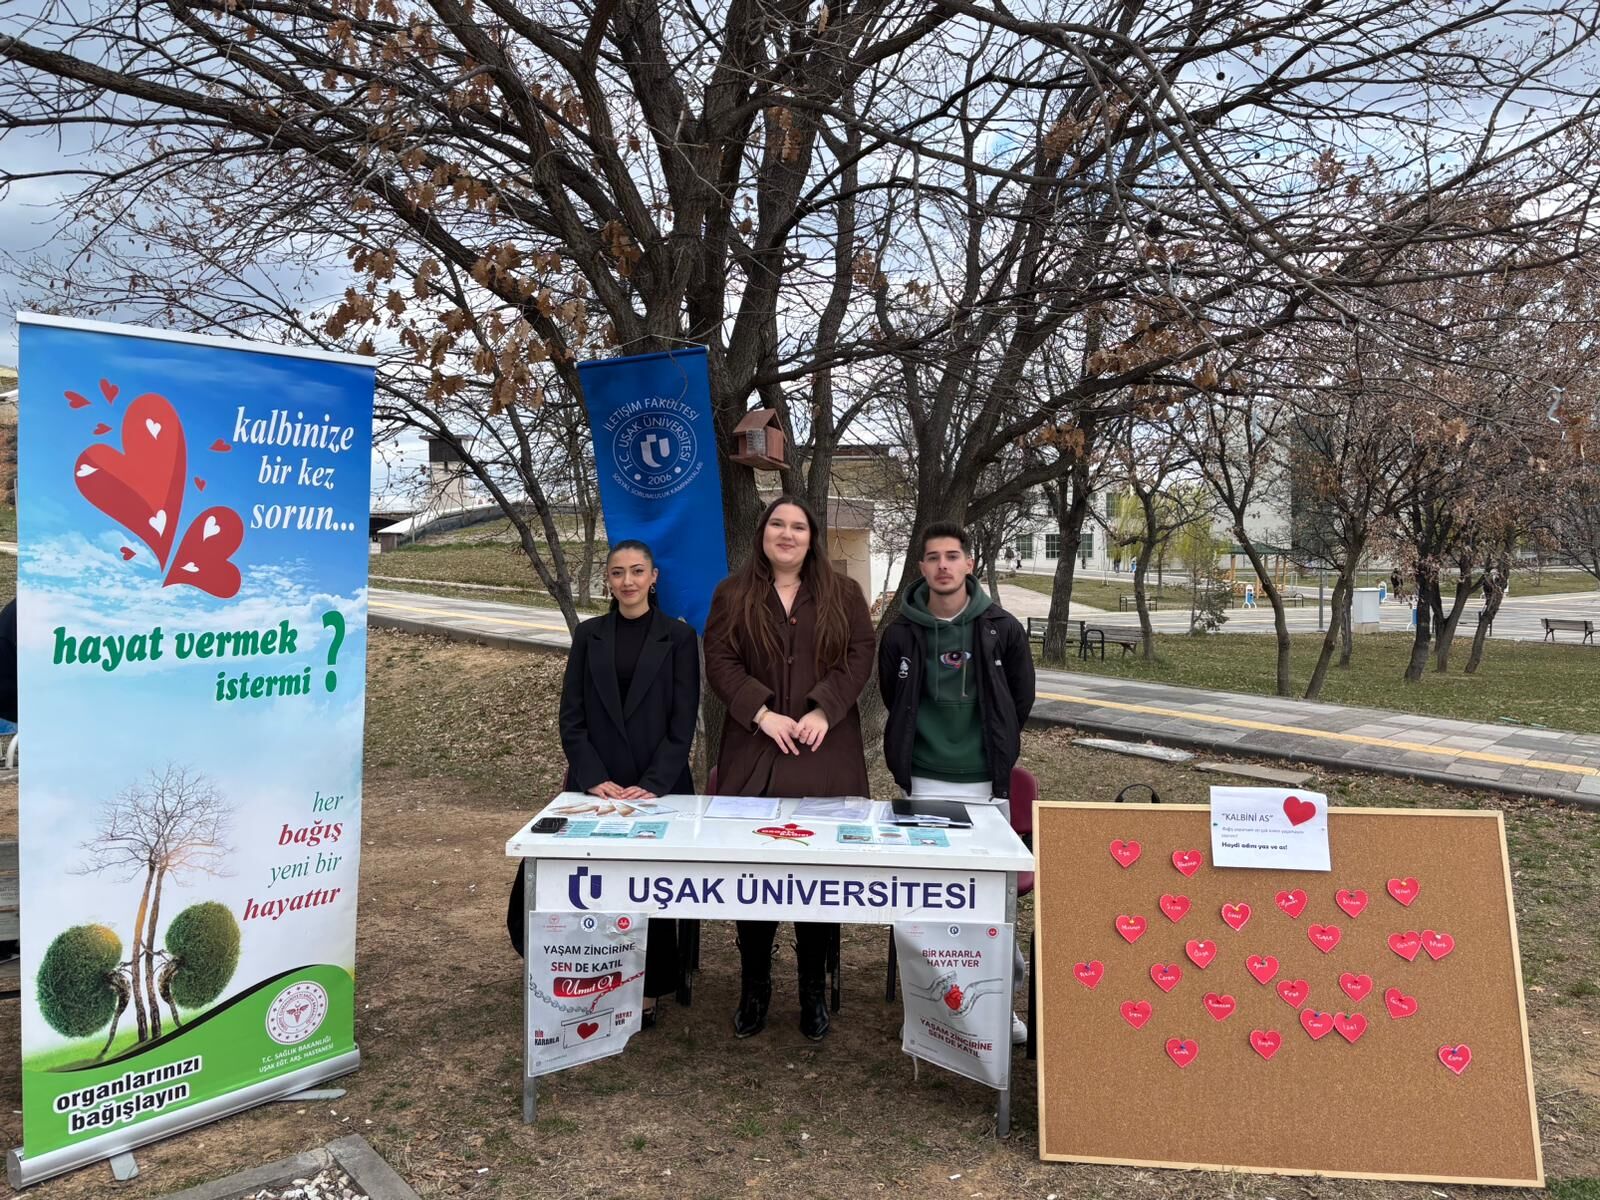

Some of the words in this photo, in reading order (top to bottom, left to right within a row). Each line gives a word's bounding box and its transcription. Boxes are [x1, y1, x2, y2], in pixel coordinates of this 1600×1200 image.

[644, 398, 700, 421] FAKÜLTESİ
[233, 406, 354, 453] kalbinize
[618, 421, 641, 448] UŞAK
[643, 415, 692, 462] ÜNİVERSİTESİ
[258, 455, 292, 485] bir
[298, 458, 335, 489] kez
[648, 474, 672, 485] 2006
[251, 504, 355, 531] sorun...
[53, 626, 163, 672] hayat
[175, 619, 298, 659] vermek
[216, 666, 312, 701] istermi
[312, 791, 344, 813] her
[278, 819, 343, 847] bağış
[267, 856, 310, 888] yeni
[315, 852, 342, 874] bir
[243, 887, 341, 921] hayattır
[628, 876, 725, 910] UŞAK
[737, 873, 976, 909] ÜNİVERSİTESİ
[544, 945, 581, 956] YAŞAM
[584, 943, 636, 955] ZİNCİRİNE
[922, 948, 937, 958] BİR
[939, 950, 982, 958] KARARLA
[927, 959, 958, 968] HAYAT
[961, 960, 979, 968] VER
[551, 962, 572, 972] SEN
[575, 963, 589, 972] DE
[592, 960, 623, 972] KATIL
[928, 1028, 944, 1041] SEN
[945, 1036, 956, 1047] DE
[56, 1057, 200, 1111] organlarınızı
[71, 1083, 187, 1132] bağışlayın
